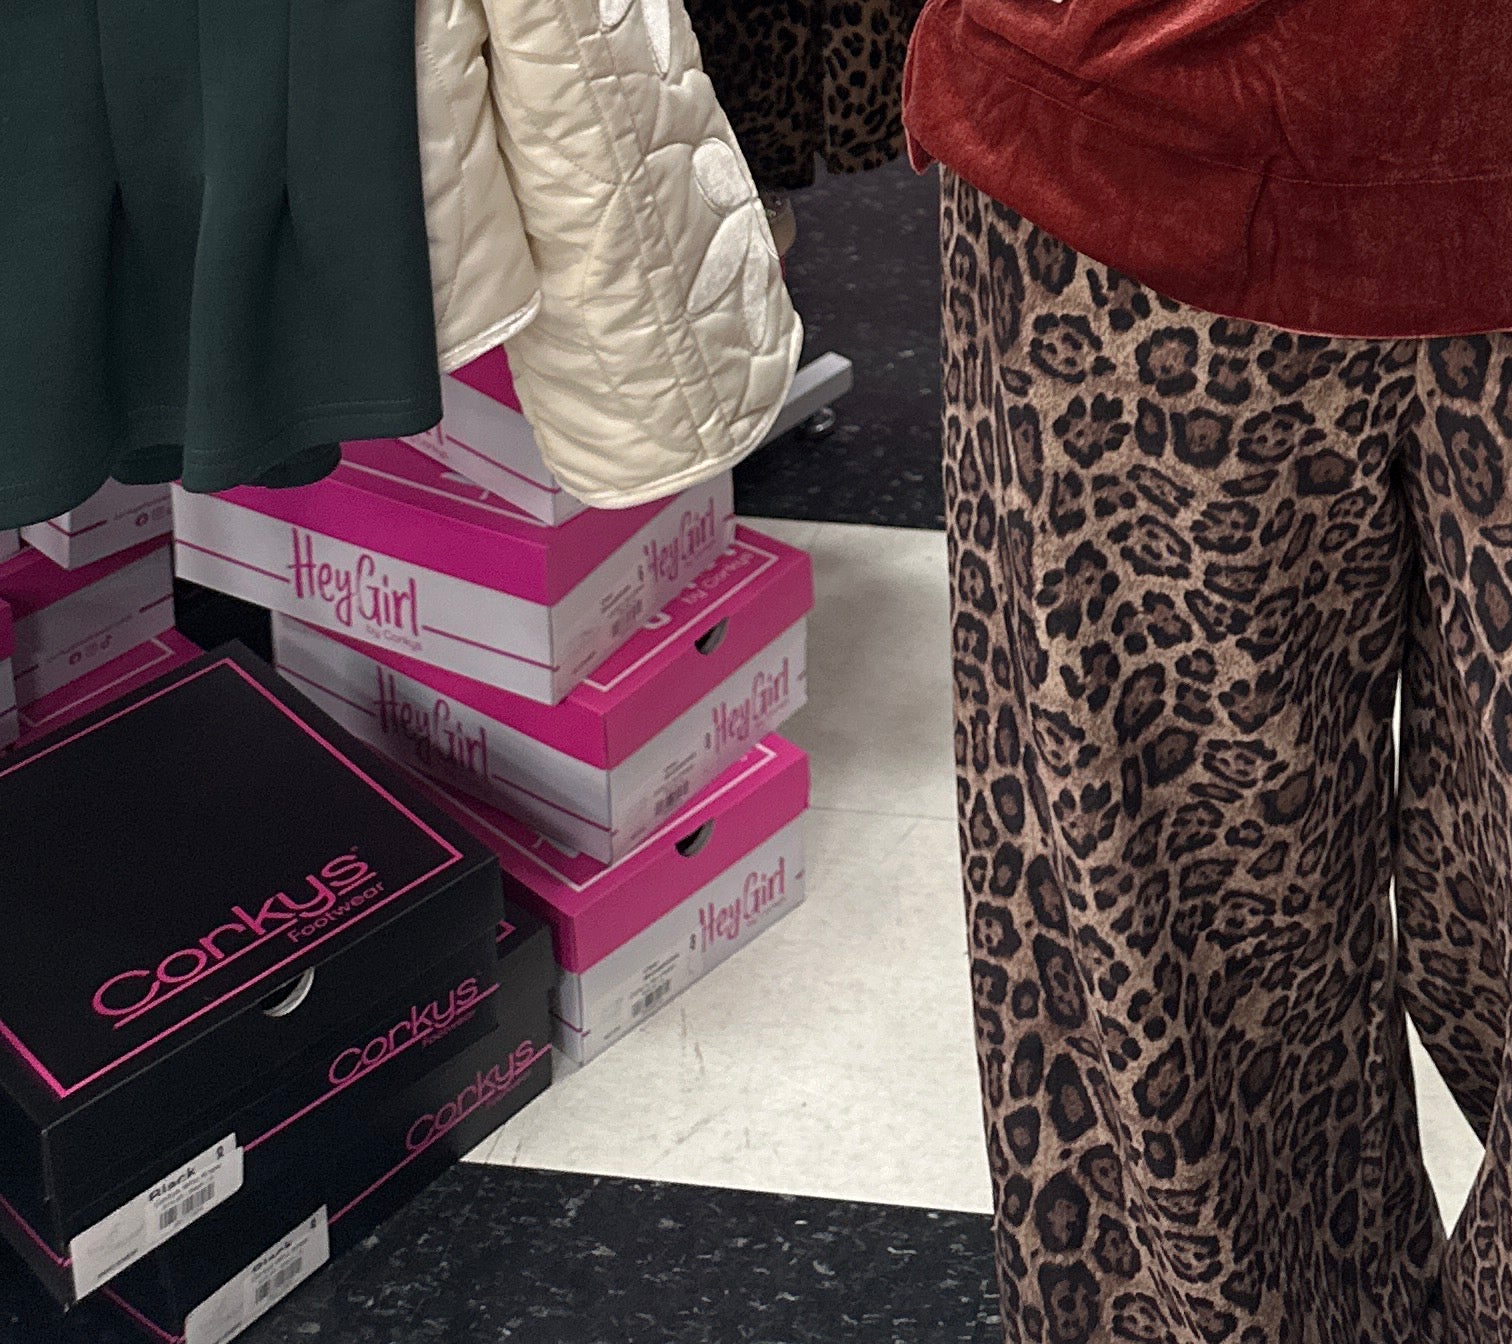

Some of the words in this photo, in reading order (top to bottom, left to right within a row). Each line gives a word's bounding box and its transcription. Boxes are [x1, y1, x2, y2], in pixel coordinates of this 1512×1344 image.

[90, 853, 369, 1016] Corkys
[286, 881, 386, 943] Footwear
[329, 977, 479, 1084] Corkys
[406, 1039, 536, 1150] Corkys
